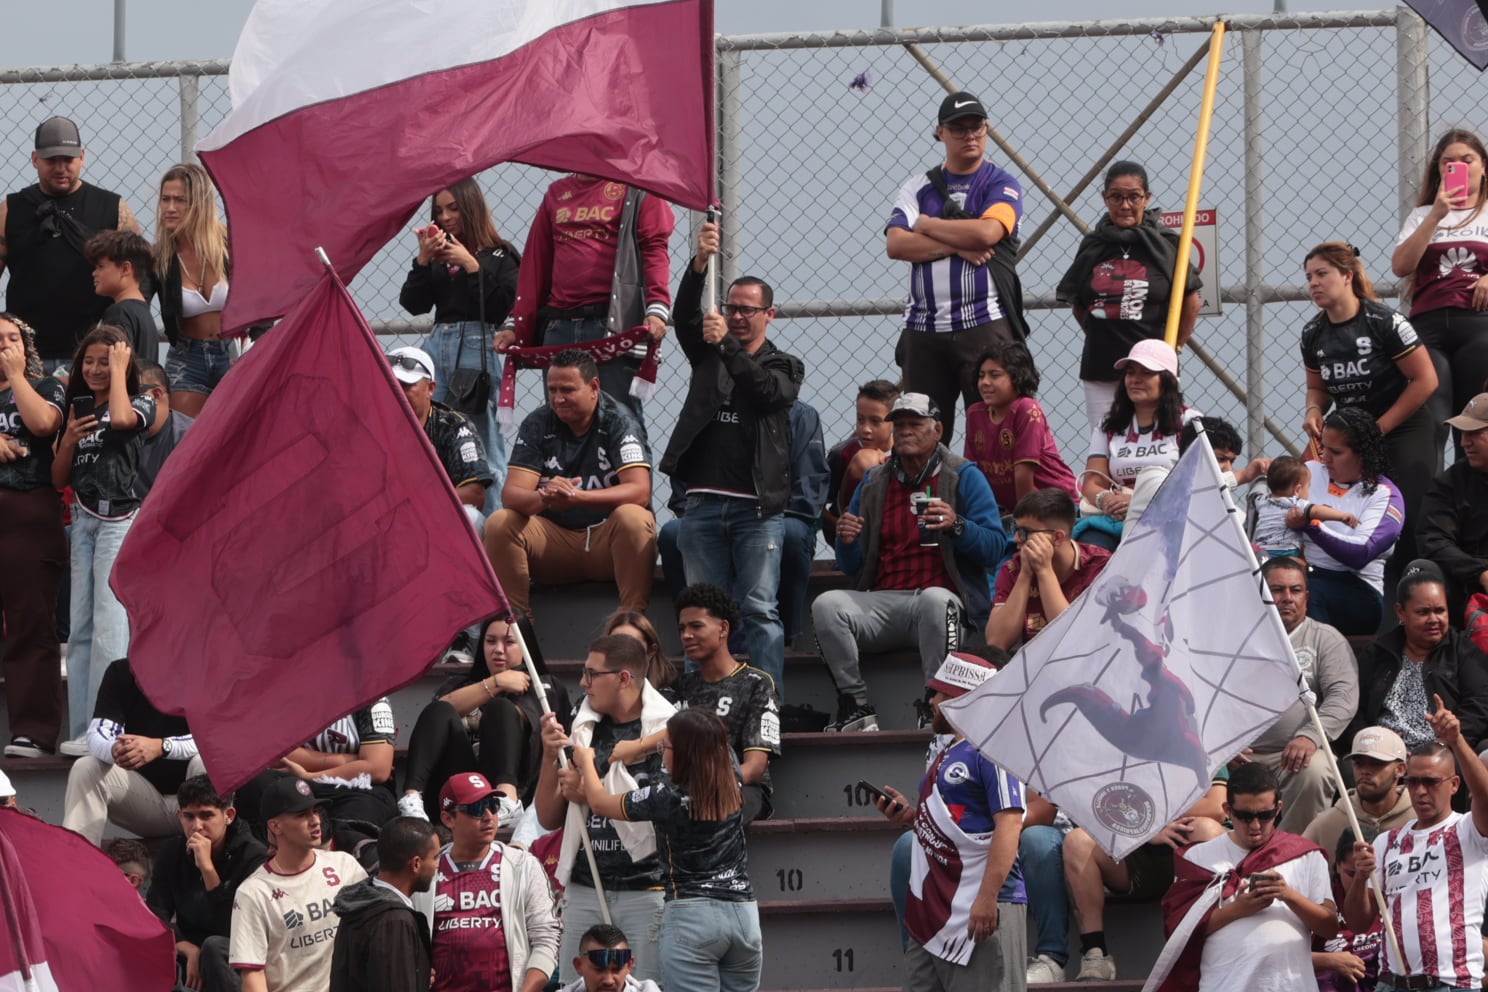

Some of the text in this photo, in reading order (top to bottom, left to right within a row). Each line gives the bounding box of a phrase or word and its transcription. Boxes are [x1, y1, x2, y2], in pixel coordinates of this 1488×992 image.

[574, 206, 614, 221] BAC
[1333, 359, 1371, 380] BAC
[1135, 443, 1168, 459] BAC
[775, 867, 804, 892] 10
[307, 897, 336, 921] BA
[459, 889, 501, 910] BAC
[437, 916, 501, 934] LIBERTY
[290, 926, 338, 949] LIBERT
[831, 947, 855, 973] 11
